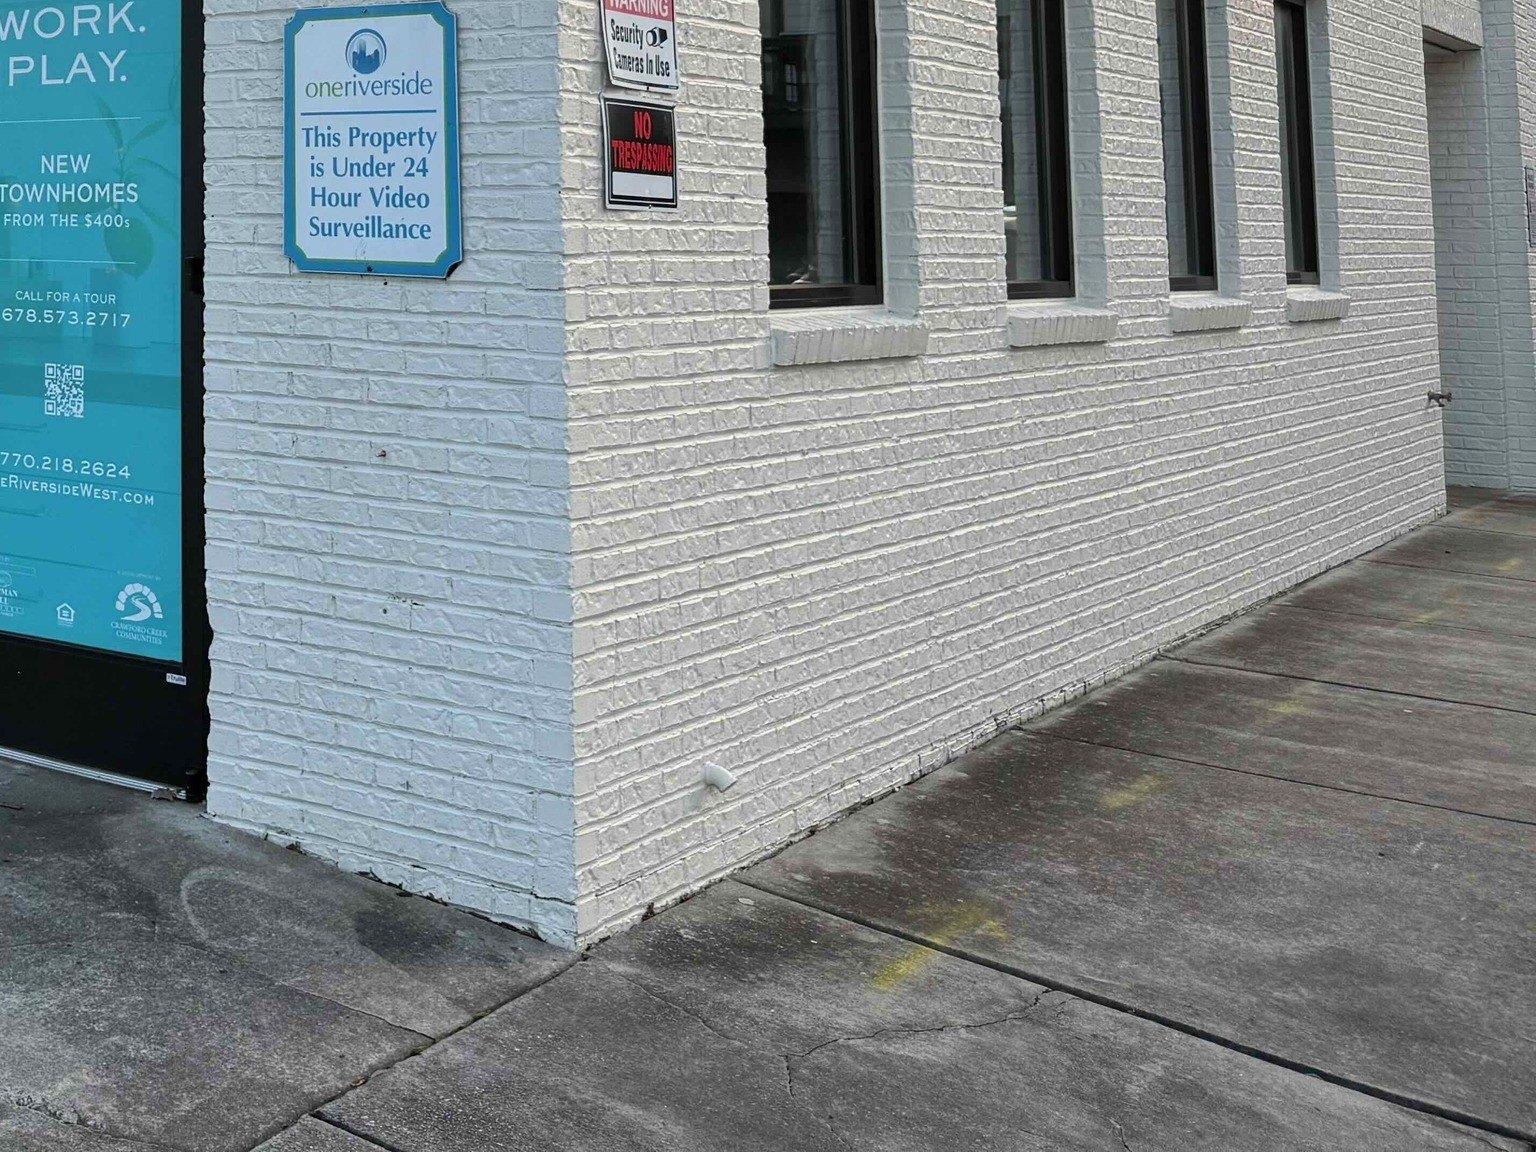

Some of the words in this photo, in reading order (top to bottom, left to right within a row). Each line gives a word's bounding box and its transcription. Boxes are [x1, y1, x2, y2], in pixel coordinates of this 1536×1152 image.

[610, 18, 644, 50] Security
[8, 49, 128, 87] PLAY.
[613, 46, 644, 74] Cameras
[645, 52, 654, 75] In
[654, 54, 671, 77] Use
[305, 70, 433, 99] oneriverside
[633, 109, 652, 141] NO
[301, 126, 341, 149] This
[348, 126, 438, 155] Property
[40, 153, 92, 174] NEW
[310, 154, 325, 178] is
[332, 154, 396, 178] Under
[403, 156, 429, 178] 24
[611, 138, 674, 175] TRESPASSING
[310, 186, 362, 209] Hour
[369, 185, 431, 209] Video
[3, 213, 45, 228] FROM
[50, 213, 79, 228] THE
[84, 213, 130, 229] $400s
[308, 215, 432, 240] Surveillance
[15, 290, 44, 301] CALL
[46, 291, 70, 302] FOR
[73, 292, 81, 302] A
[83, 293, 116, 305] TOUR
[1, 307, 131, 328] 678.573.2717
[0, 451, 132, 479] 770.218.2624
